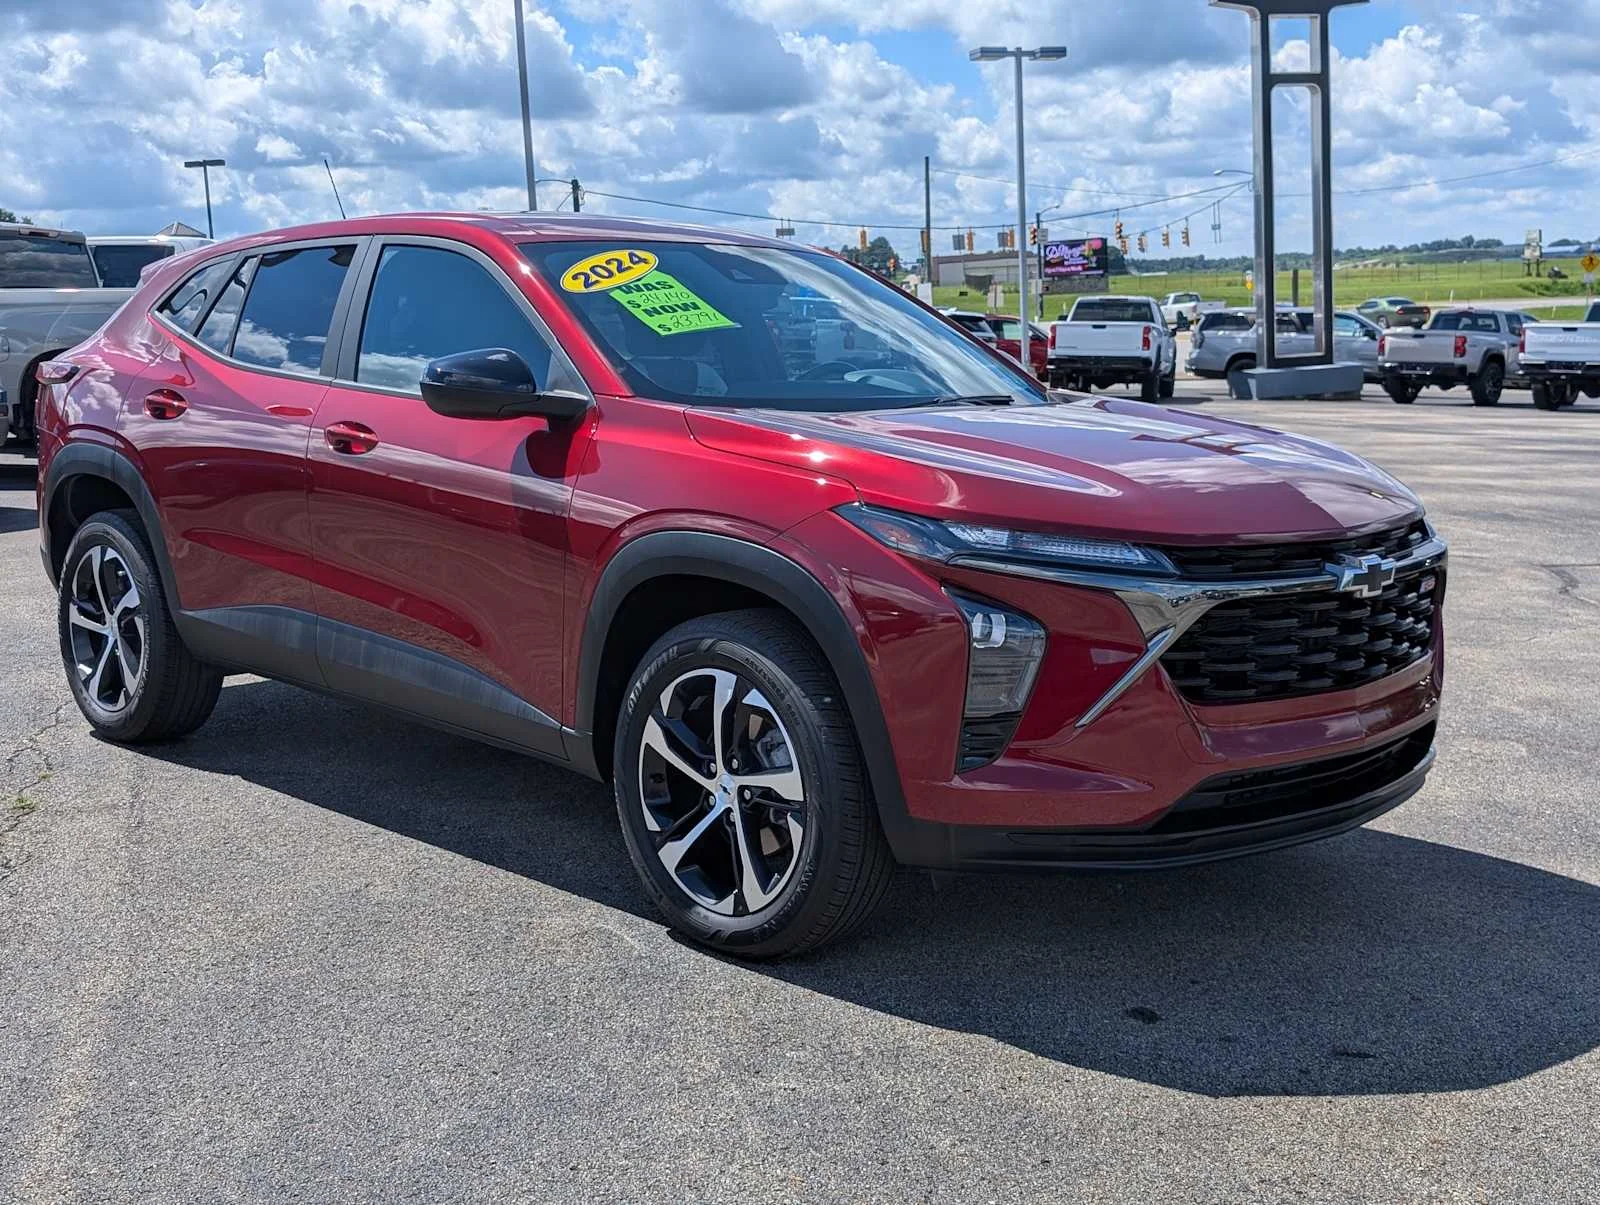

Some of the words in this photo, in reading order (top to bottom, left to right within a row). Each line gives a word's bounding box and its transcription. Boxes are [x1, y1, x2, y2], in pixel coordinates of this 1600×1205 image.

[571, 251, 650, 289] 2024
[617, 281, 675, 295] WAS
[641, 301, 701, 317] NOW
